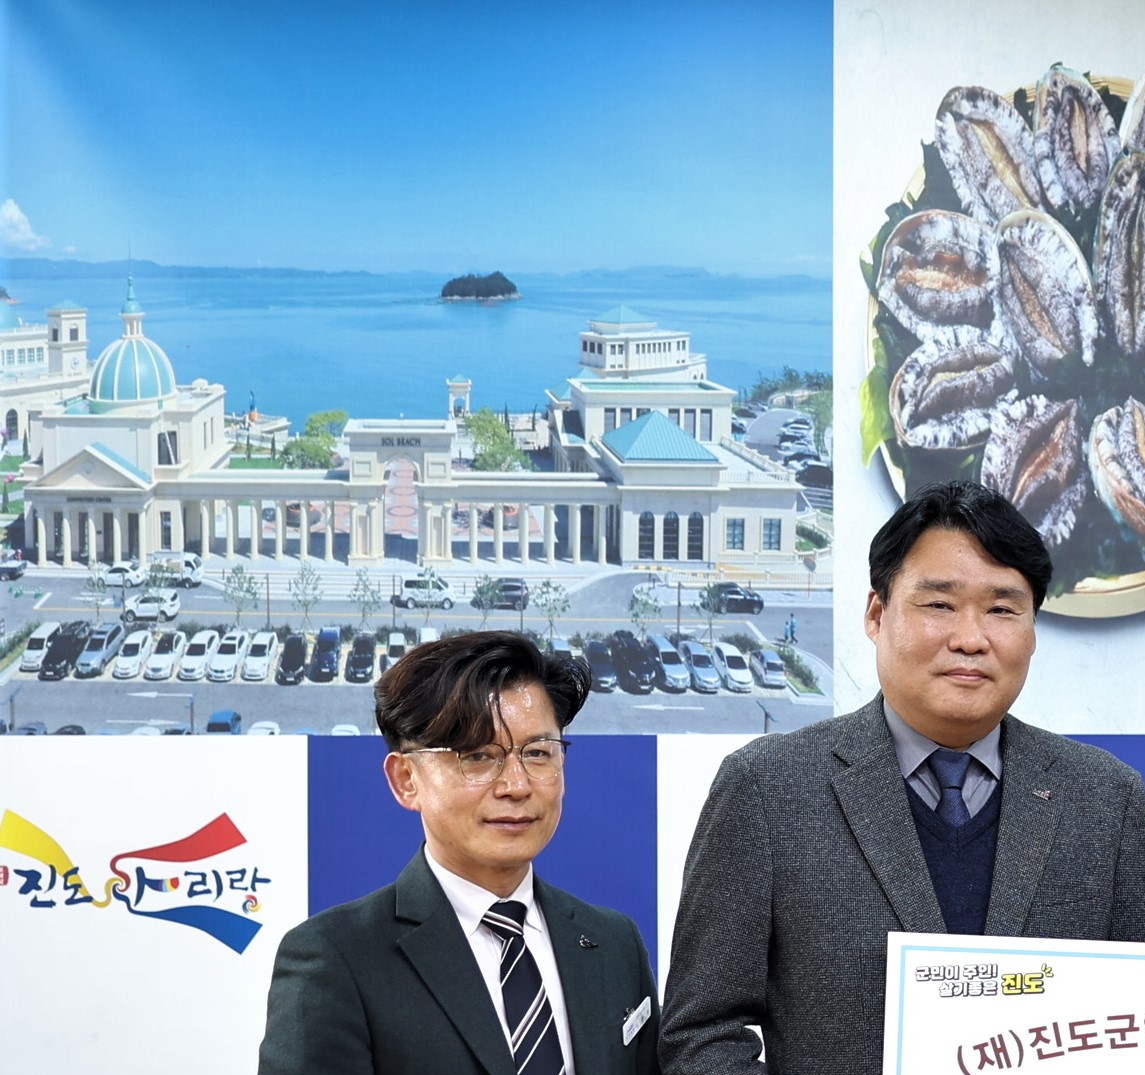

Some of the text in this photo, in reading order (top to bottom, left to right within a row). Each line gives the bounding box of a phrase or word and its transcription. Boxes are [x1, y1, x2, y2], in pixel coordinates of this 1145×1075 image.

[915, 963, 998, 981] 군민이 주인!
[939, 972, 1045, 997] 살기좋은 진도
